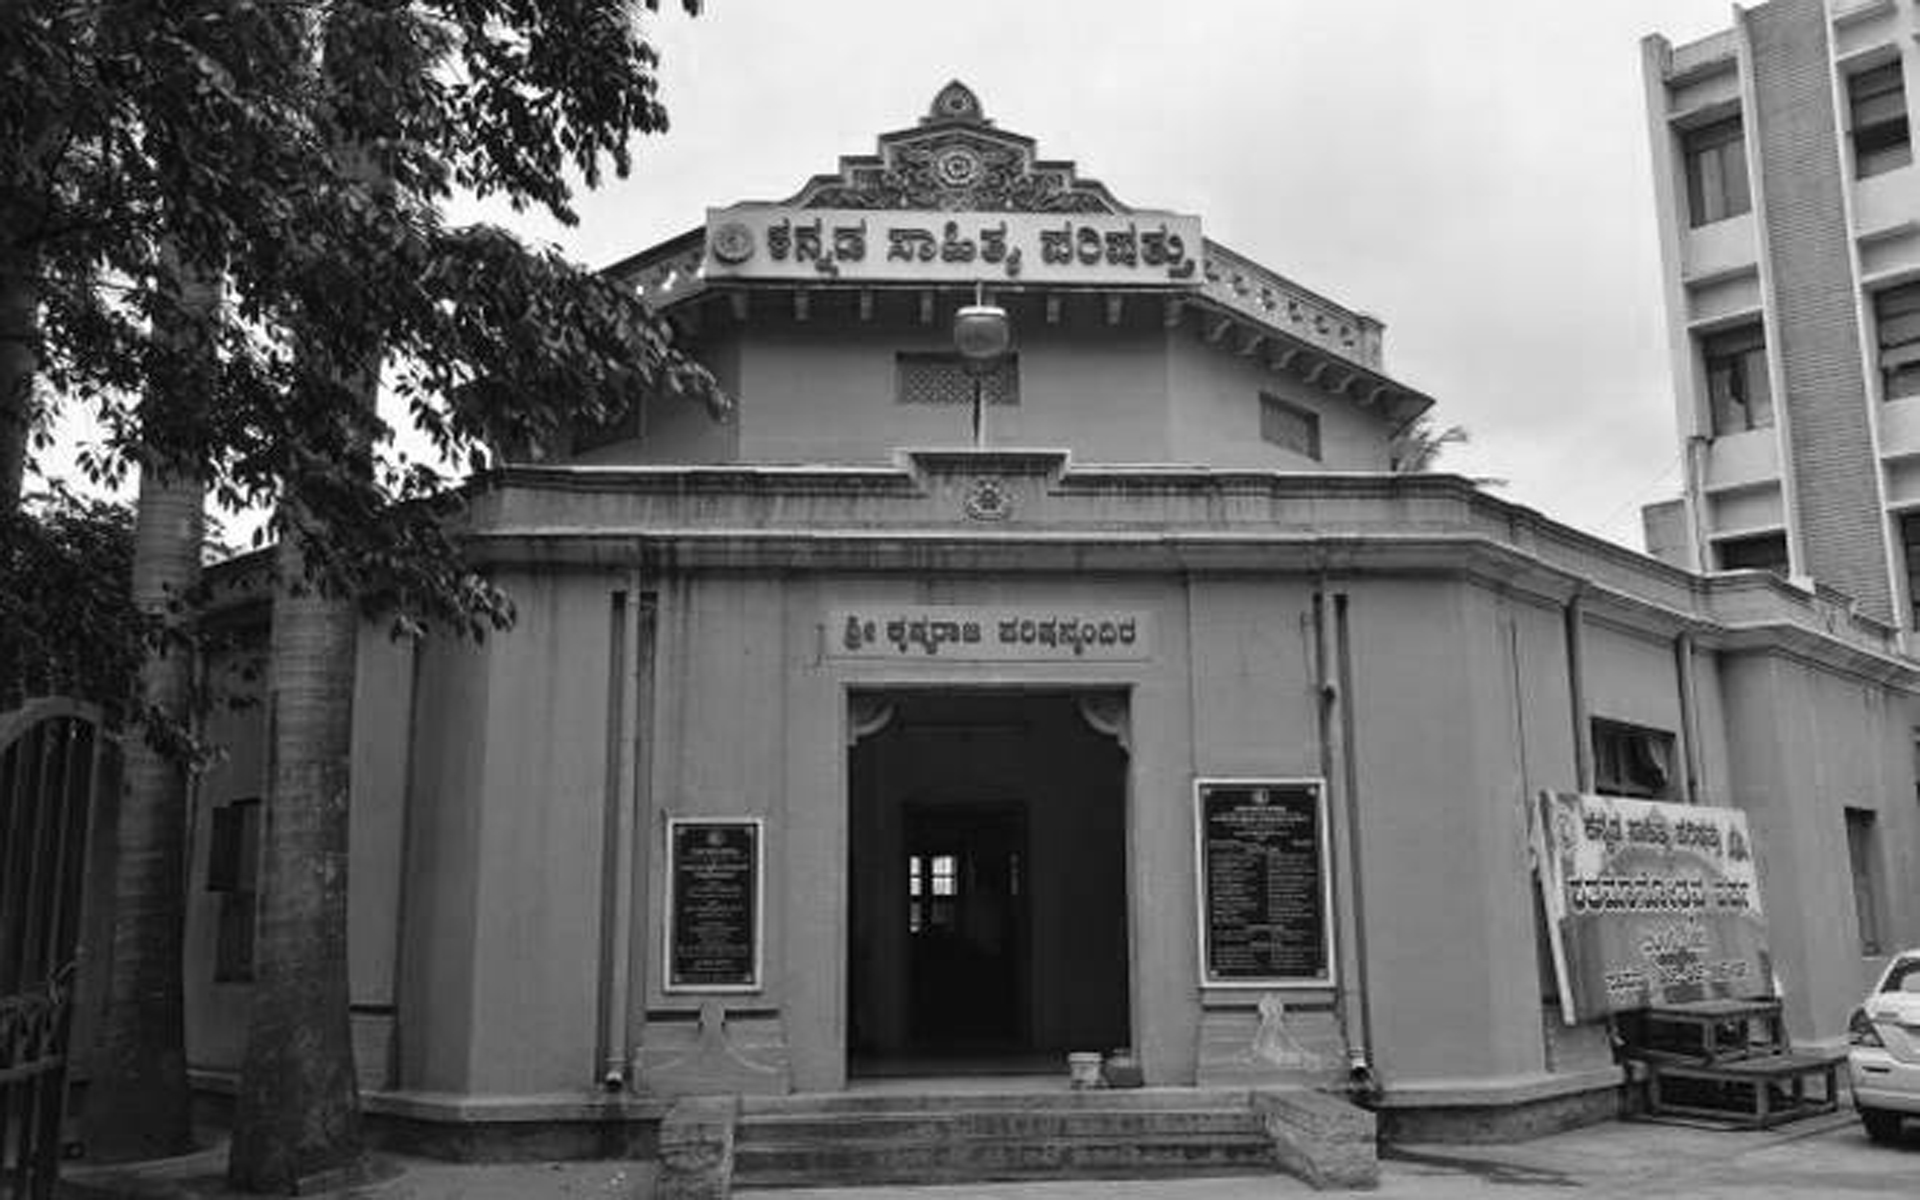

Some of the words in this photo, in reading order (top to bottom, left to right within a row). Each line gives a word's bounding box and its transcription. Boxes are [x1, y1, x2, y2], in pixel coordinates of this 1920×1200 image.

[767, 218, 866, 278] ಕನ್ನಡ
[887, 220, 1023, 278] ಸಾಹಿತ್ಯ
[1040, 220, 1195, 280] ಪರಿಷತ್ತು
[843, 615, 877, 650] ಶ್ರೀ
